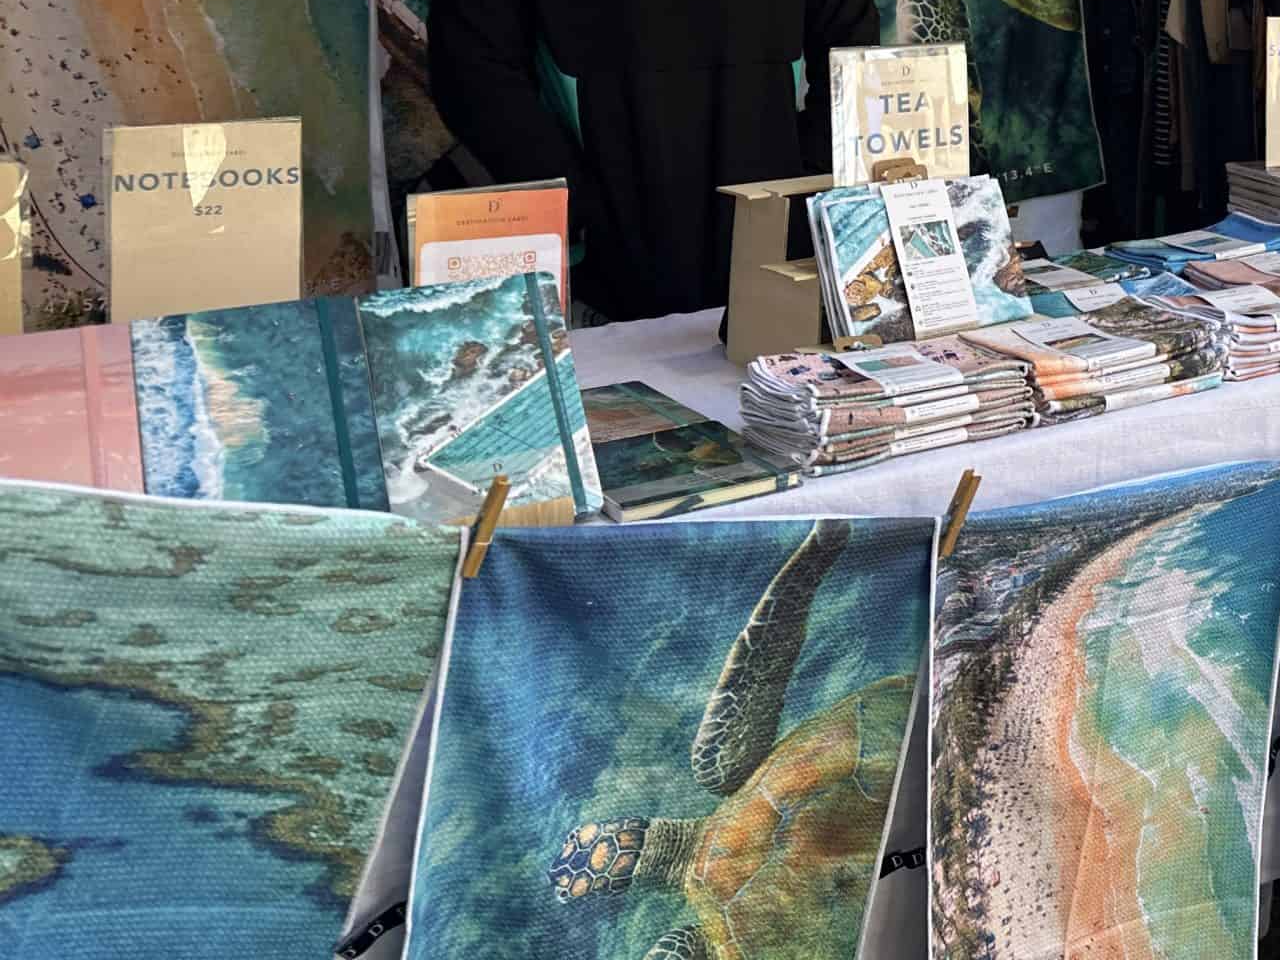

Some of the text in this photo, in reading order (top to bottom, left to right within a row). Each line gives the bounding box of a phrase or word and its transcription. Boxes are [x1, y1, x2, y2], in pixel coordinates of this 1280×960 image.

[879, 91, 930, 115] TEA
[850, 124, 963, 157] TOWELS
[194, 205, 223, 216] $22
